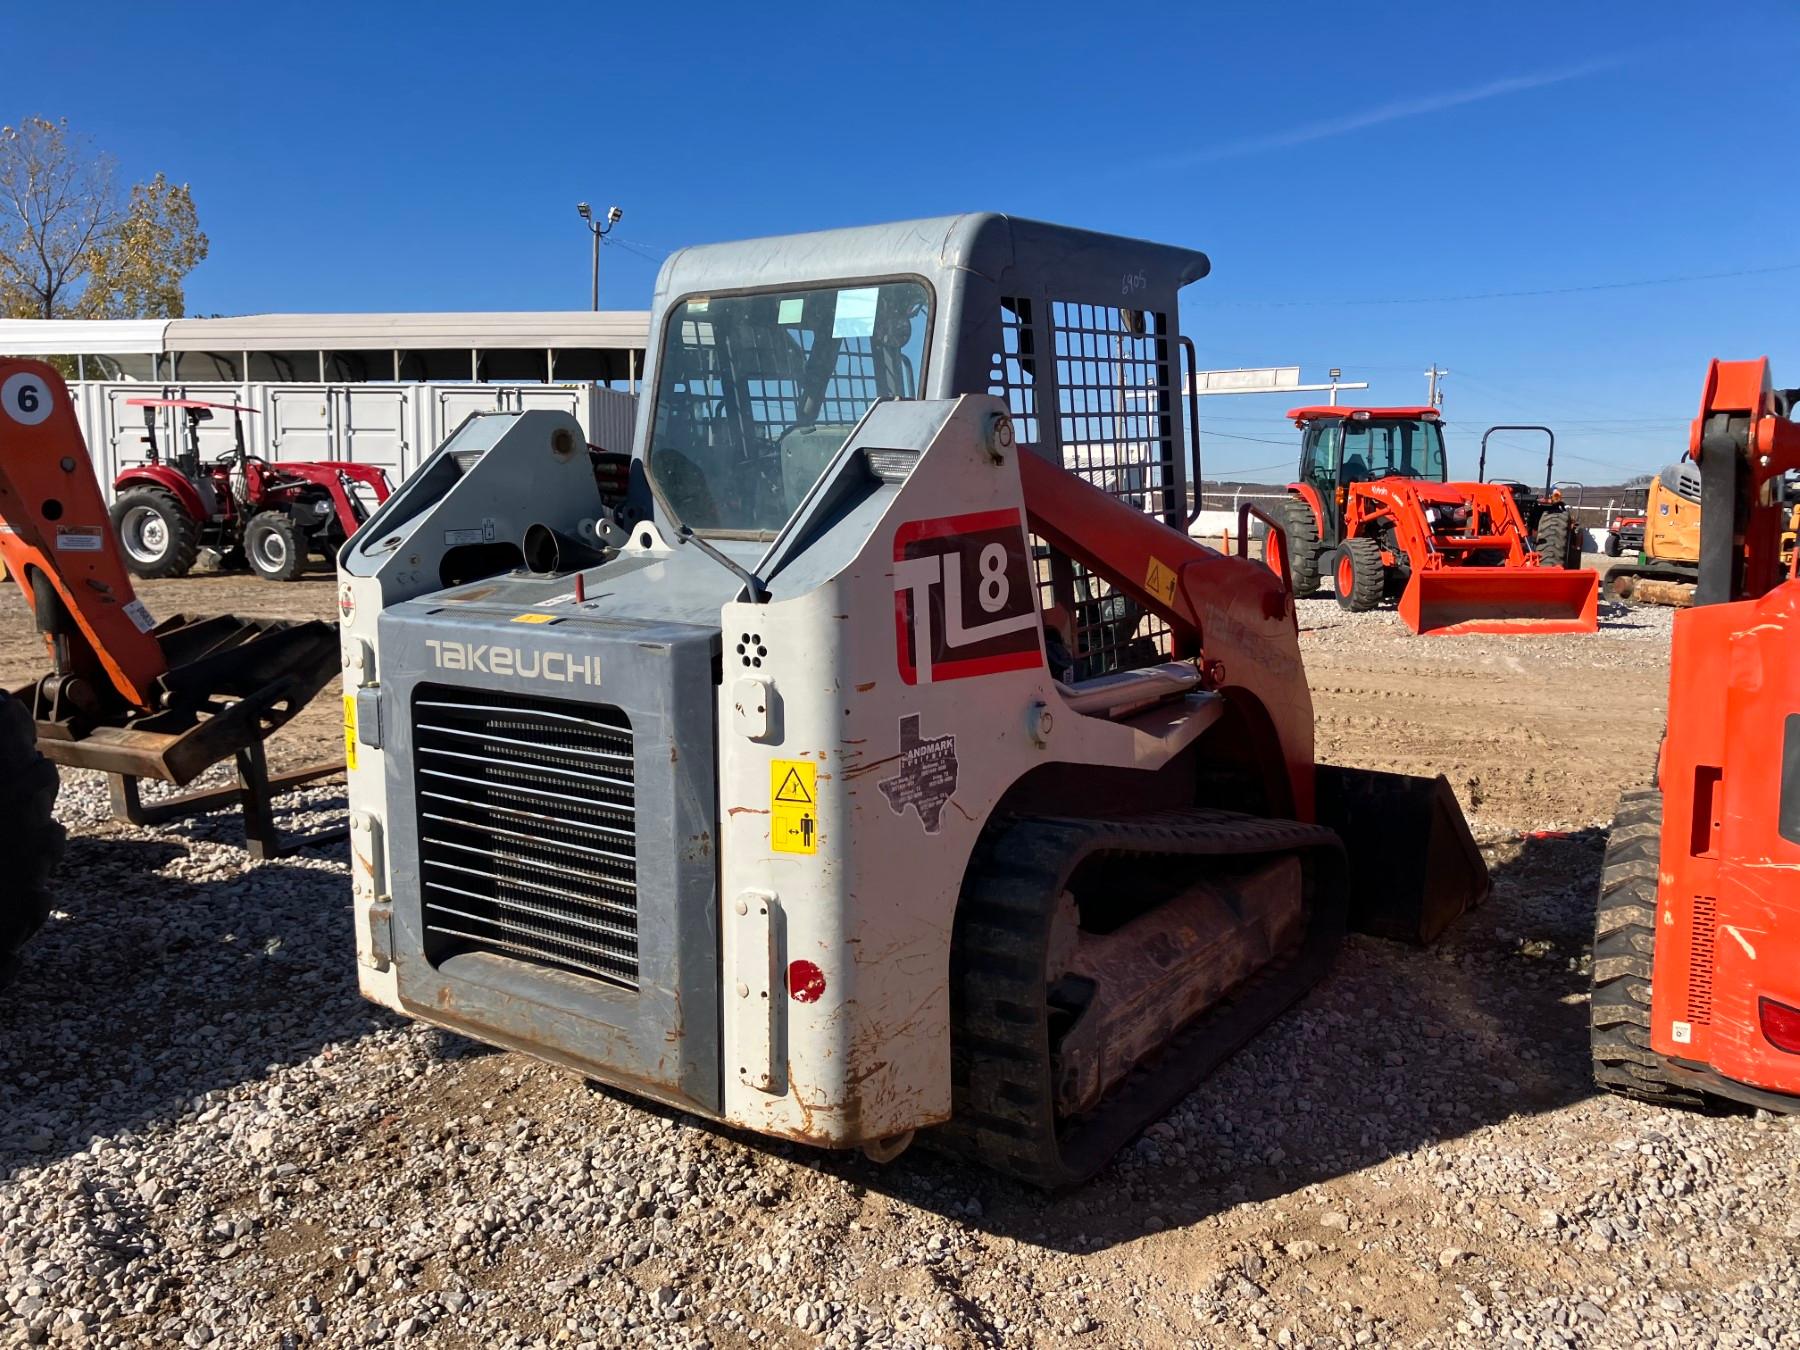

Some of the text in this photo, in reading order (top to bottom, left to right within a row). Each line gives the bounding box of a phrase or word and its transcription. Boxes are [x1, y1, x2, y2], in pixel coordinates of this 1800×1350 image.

[1121, 269, 1147, 295] 6905
[17, 384, 39, 412] 6
[425, 639, 601, 687] TAKEUCHI
